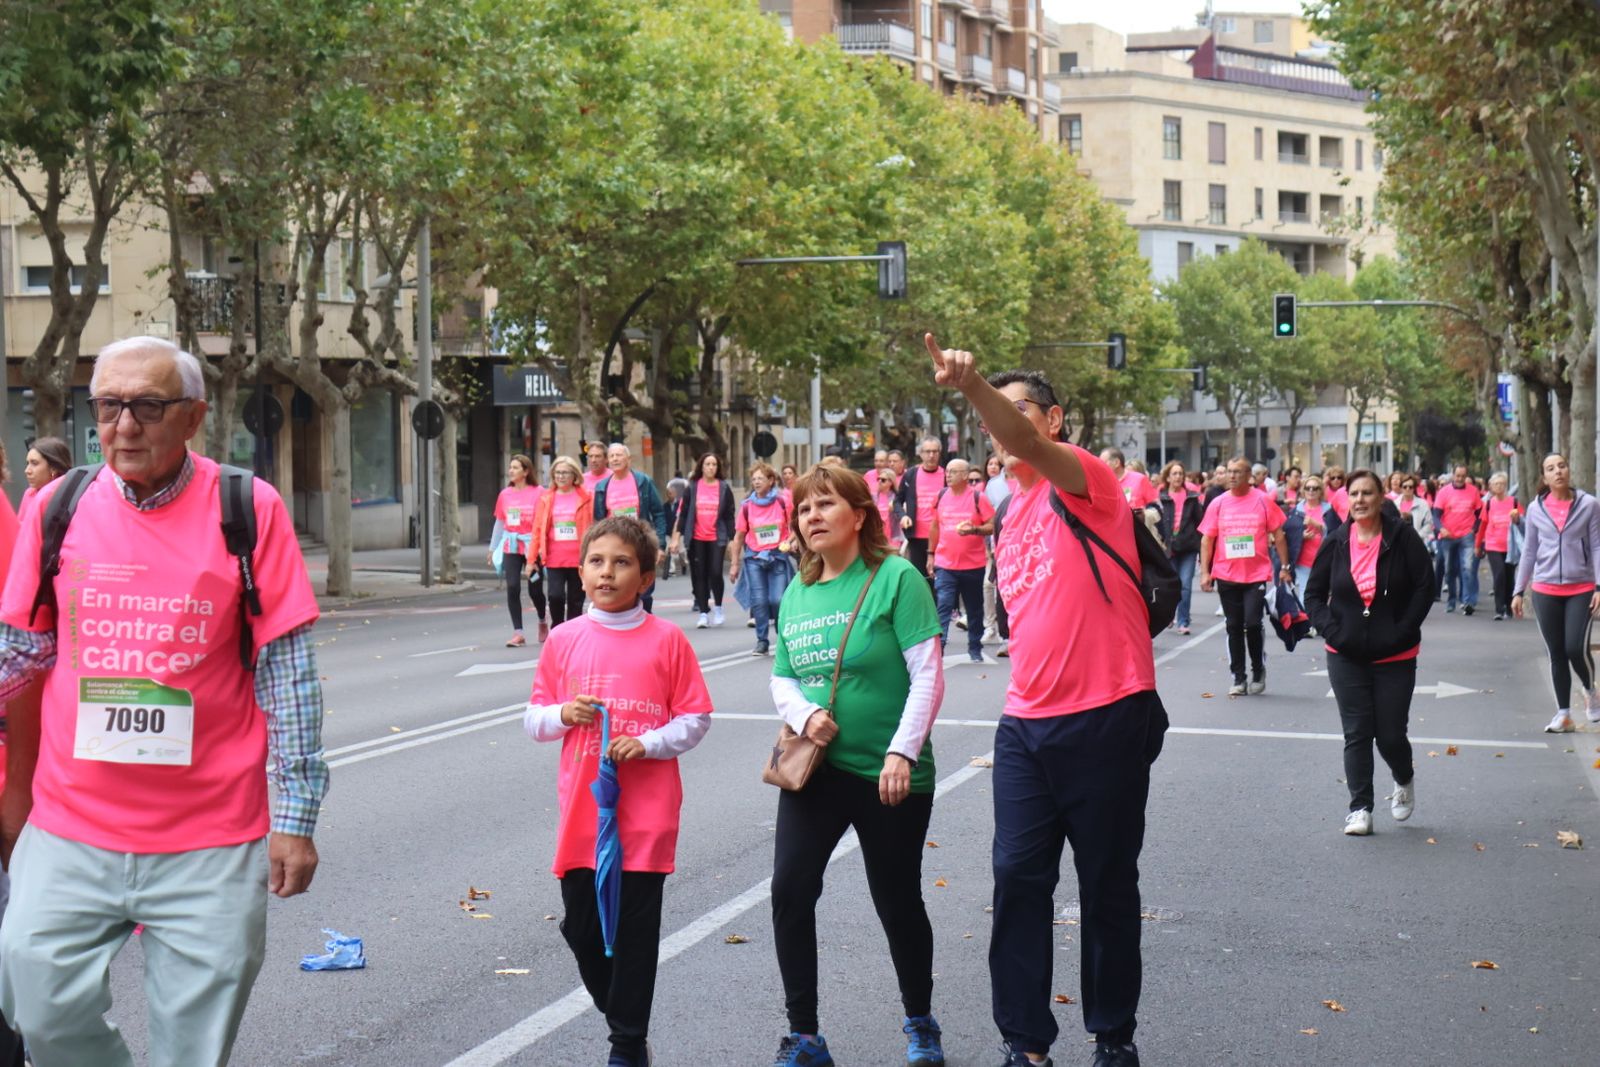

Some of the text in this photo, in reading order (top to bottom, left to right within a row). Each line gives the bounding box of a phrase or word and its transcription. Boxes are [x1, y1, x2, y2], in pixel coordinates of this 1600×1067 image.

[81, 587, 213, 616] En marcha
[81, 617, 208, 644] contra el
[782, 621, 798, 637] En
[794, 647, 838, 667] cánce
[105, 707, 165, 733] 7090
